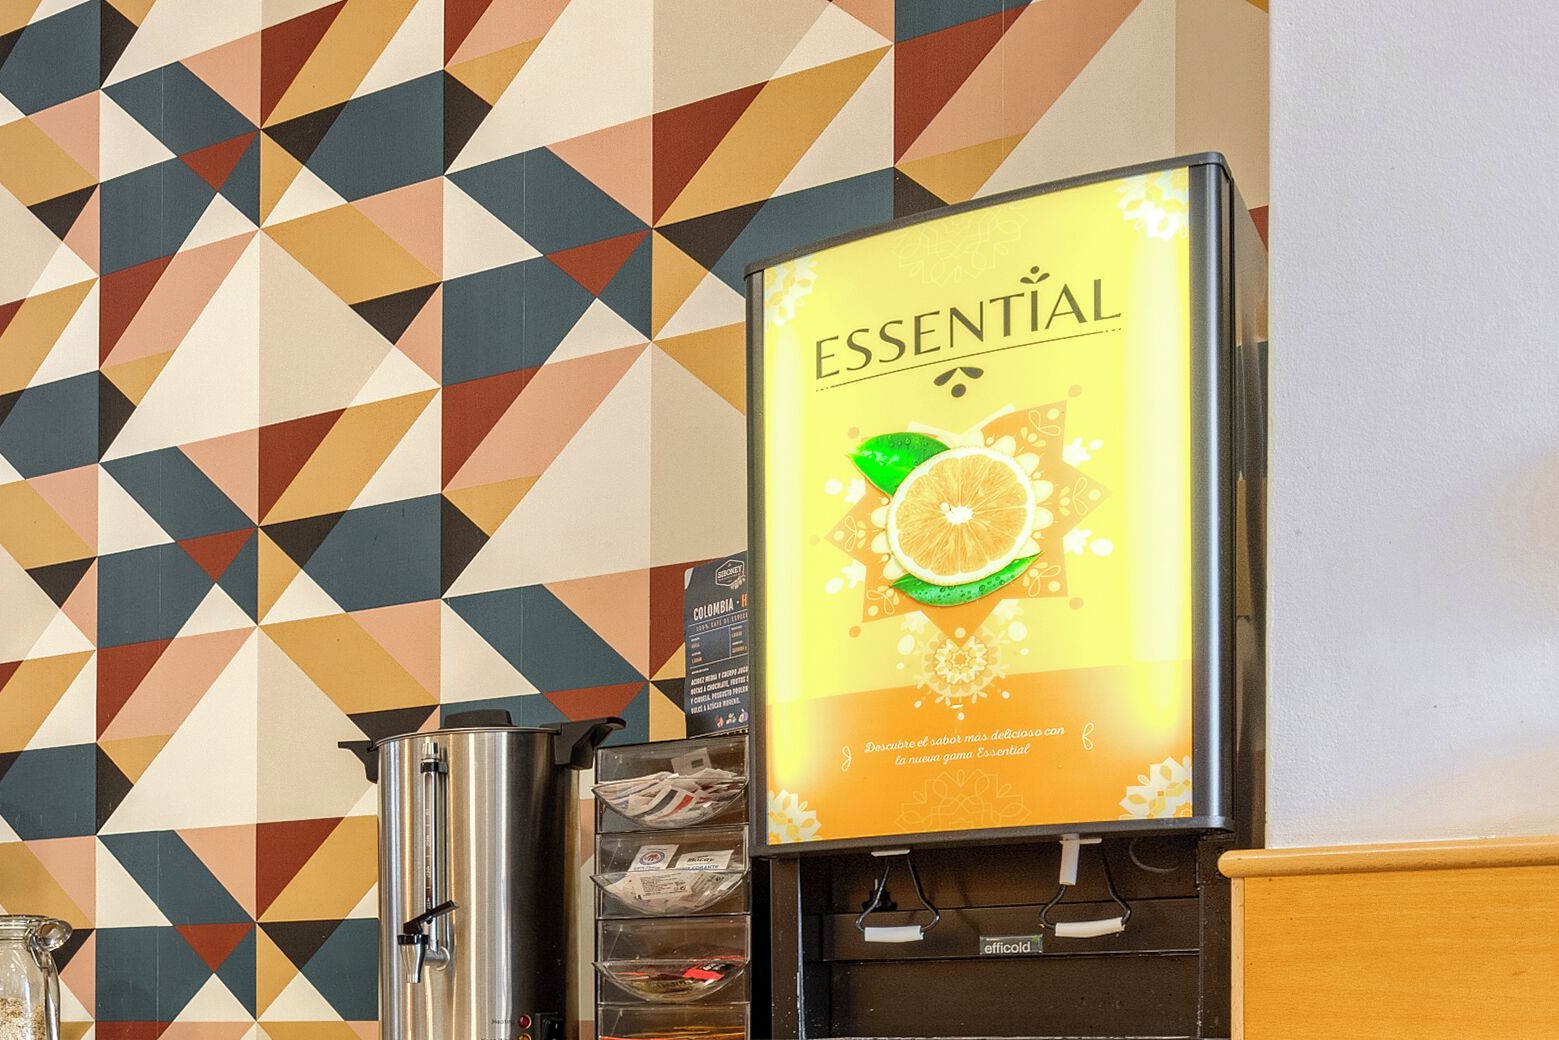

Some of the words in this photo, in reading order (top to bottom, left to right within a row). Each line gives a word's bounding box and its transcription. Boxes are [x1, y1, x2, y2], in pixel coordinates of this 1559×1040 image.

[815, 276, 1122, 380] ESSENTIAL
[693, 597, 734, 621] COLOMBIA
[864, 740, 916, 753] Descubre
[917, 737, 928, 748] el
[930, 734, 963, 747] sabor
[964, 731, 989, 743] más
[991, 727, 1042, 741] delicioso
[1043, 726, 1065, 736] con
[895, 754, 907, 765] la
[908, 753, 941, 764] nueva
[943, 750, 973, 765] gama
[976, 743, 1031, 758] Essential
[984, 940, 1032, 954] efficold
